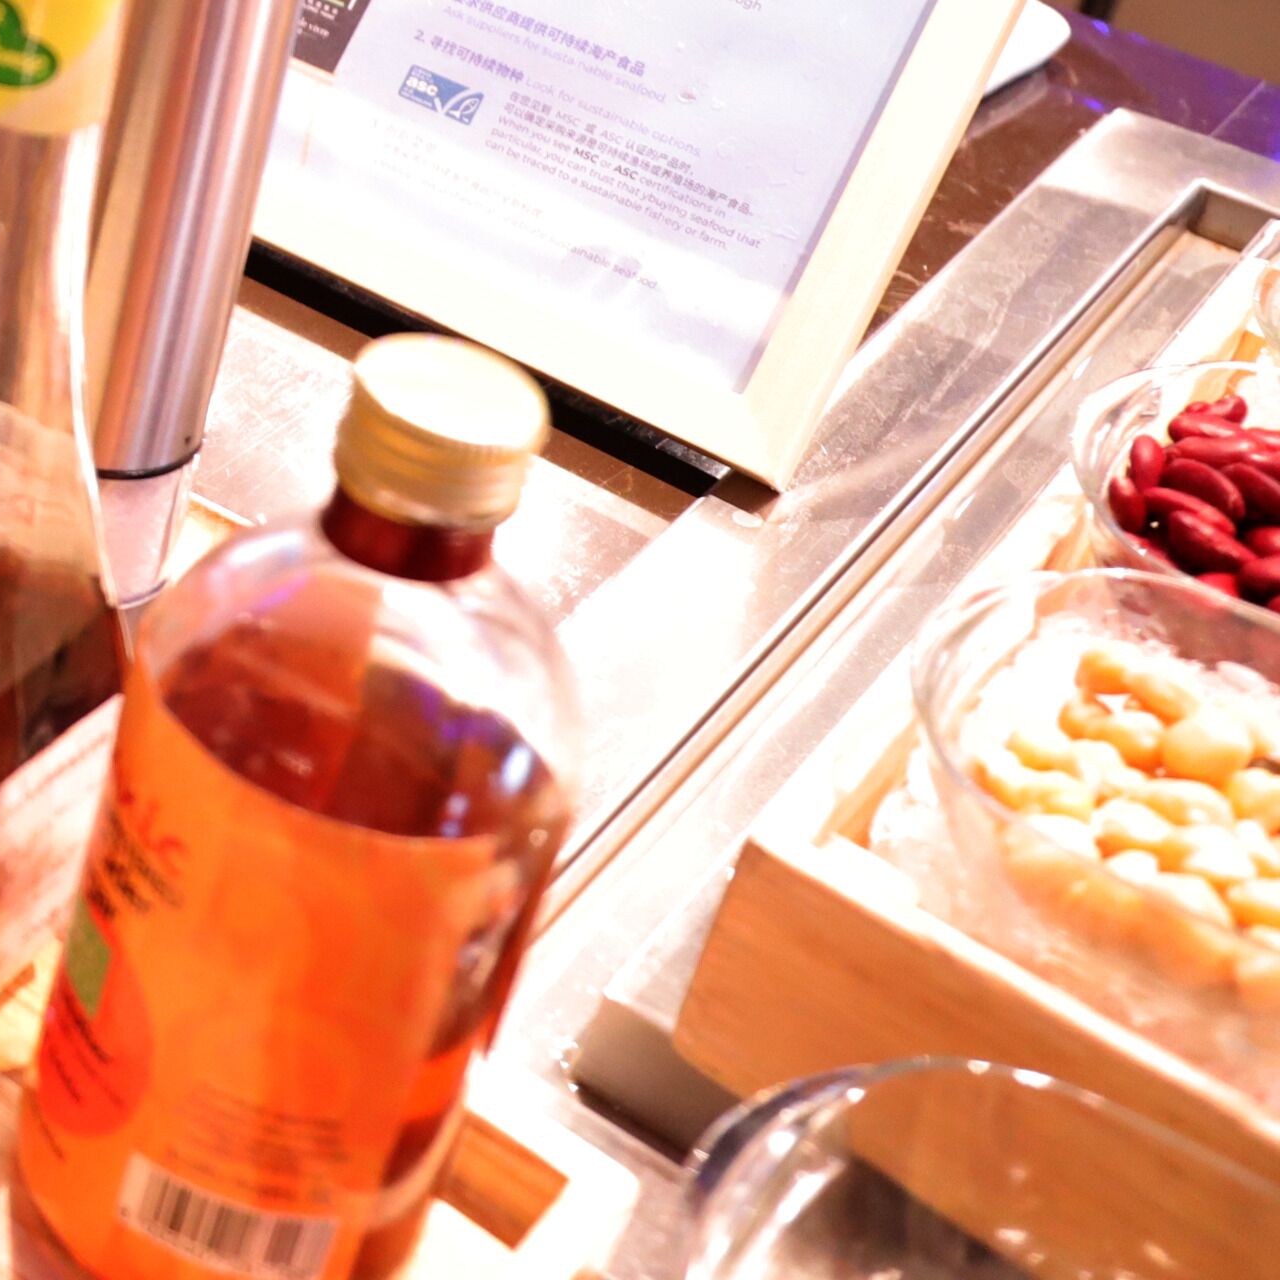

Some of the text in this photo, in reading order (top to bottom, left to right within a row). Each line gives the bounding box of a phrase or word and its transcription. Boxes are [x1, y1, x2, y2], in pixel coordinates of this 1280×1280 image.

[464, 14, 522, 45] suppliers
[521, 37, 540, 51] for
[405, 75, 438, 97] asc
[524, 76, 556, 96] Look
[556, 89, 575, 104] for
[576, 98, 651, 136] sustainable
[553, 108, 582, 128] MSC
[598, 127, 625, 146] ASC
[483, 138, 506, 154] can
[504, 147, 522, 161] be
[520, 154, 558, 176] traced
[556, 169, 571, 182] to
[569, 176, 579, 185] a
[578, 179, 644, 213] sustainable
[642, 206, 686, 233] fishery
[683, 224, 699, 237] or
[496, 114, 728, 219] When you see MSC or ASC certifications in
[543, 149, 566, 165] you
[565, 159, 588, 175] can
[587, 168, 616, 186] trust
[614, 180, 641, 197] that
[688, 211, 736, 238] seafood
[734, 231, 762, 249] that
